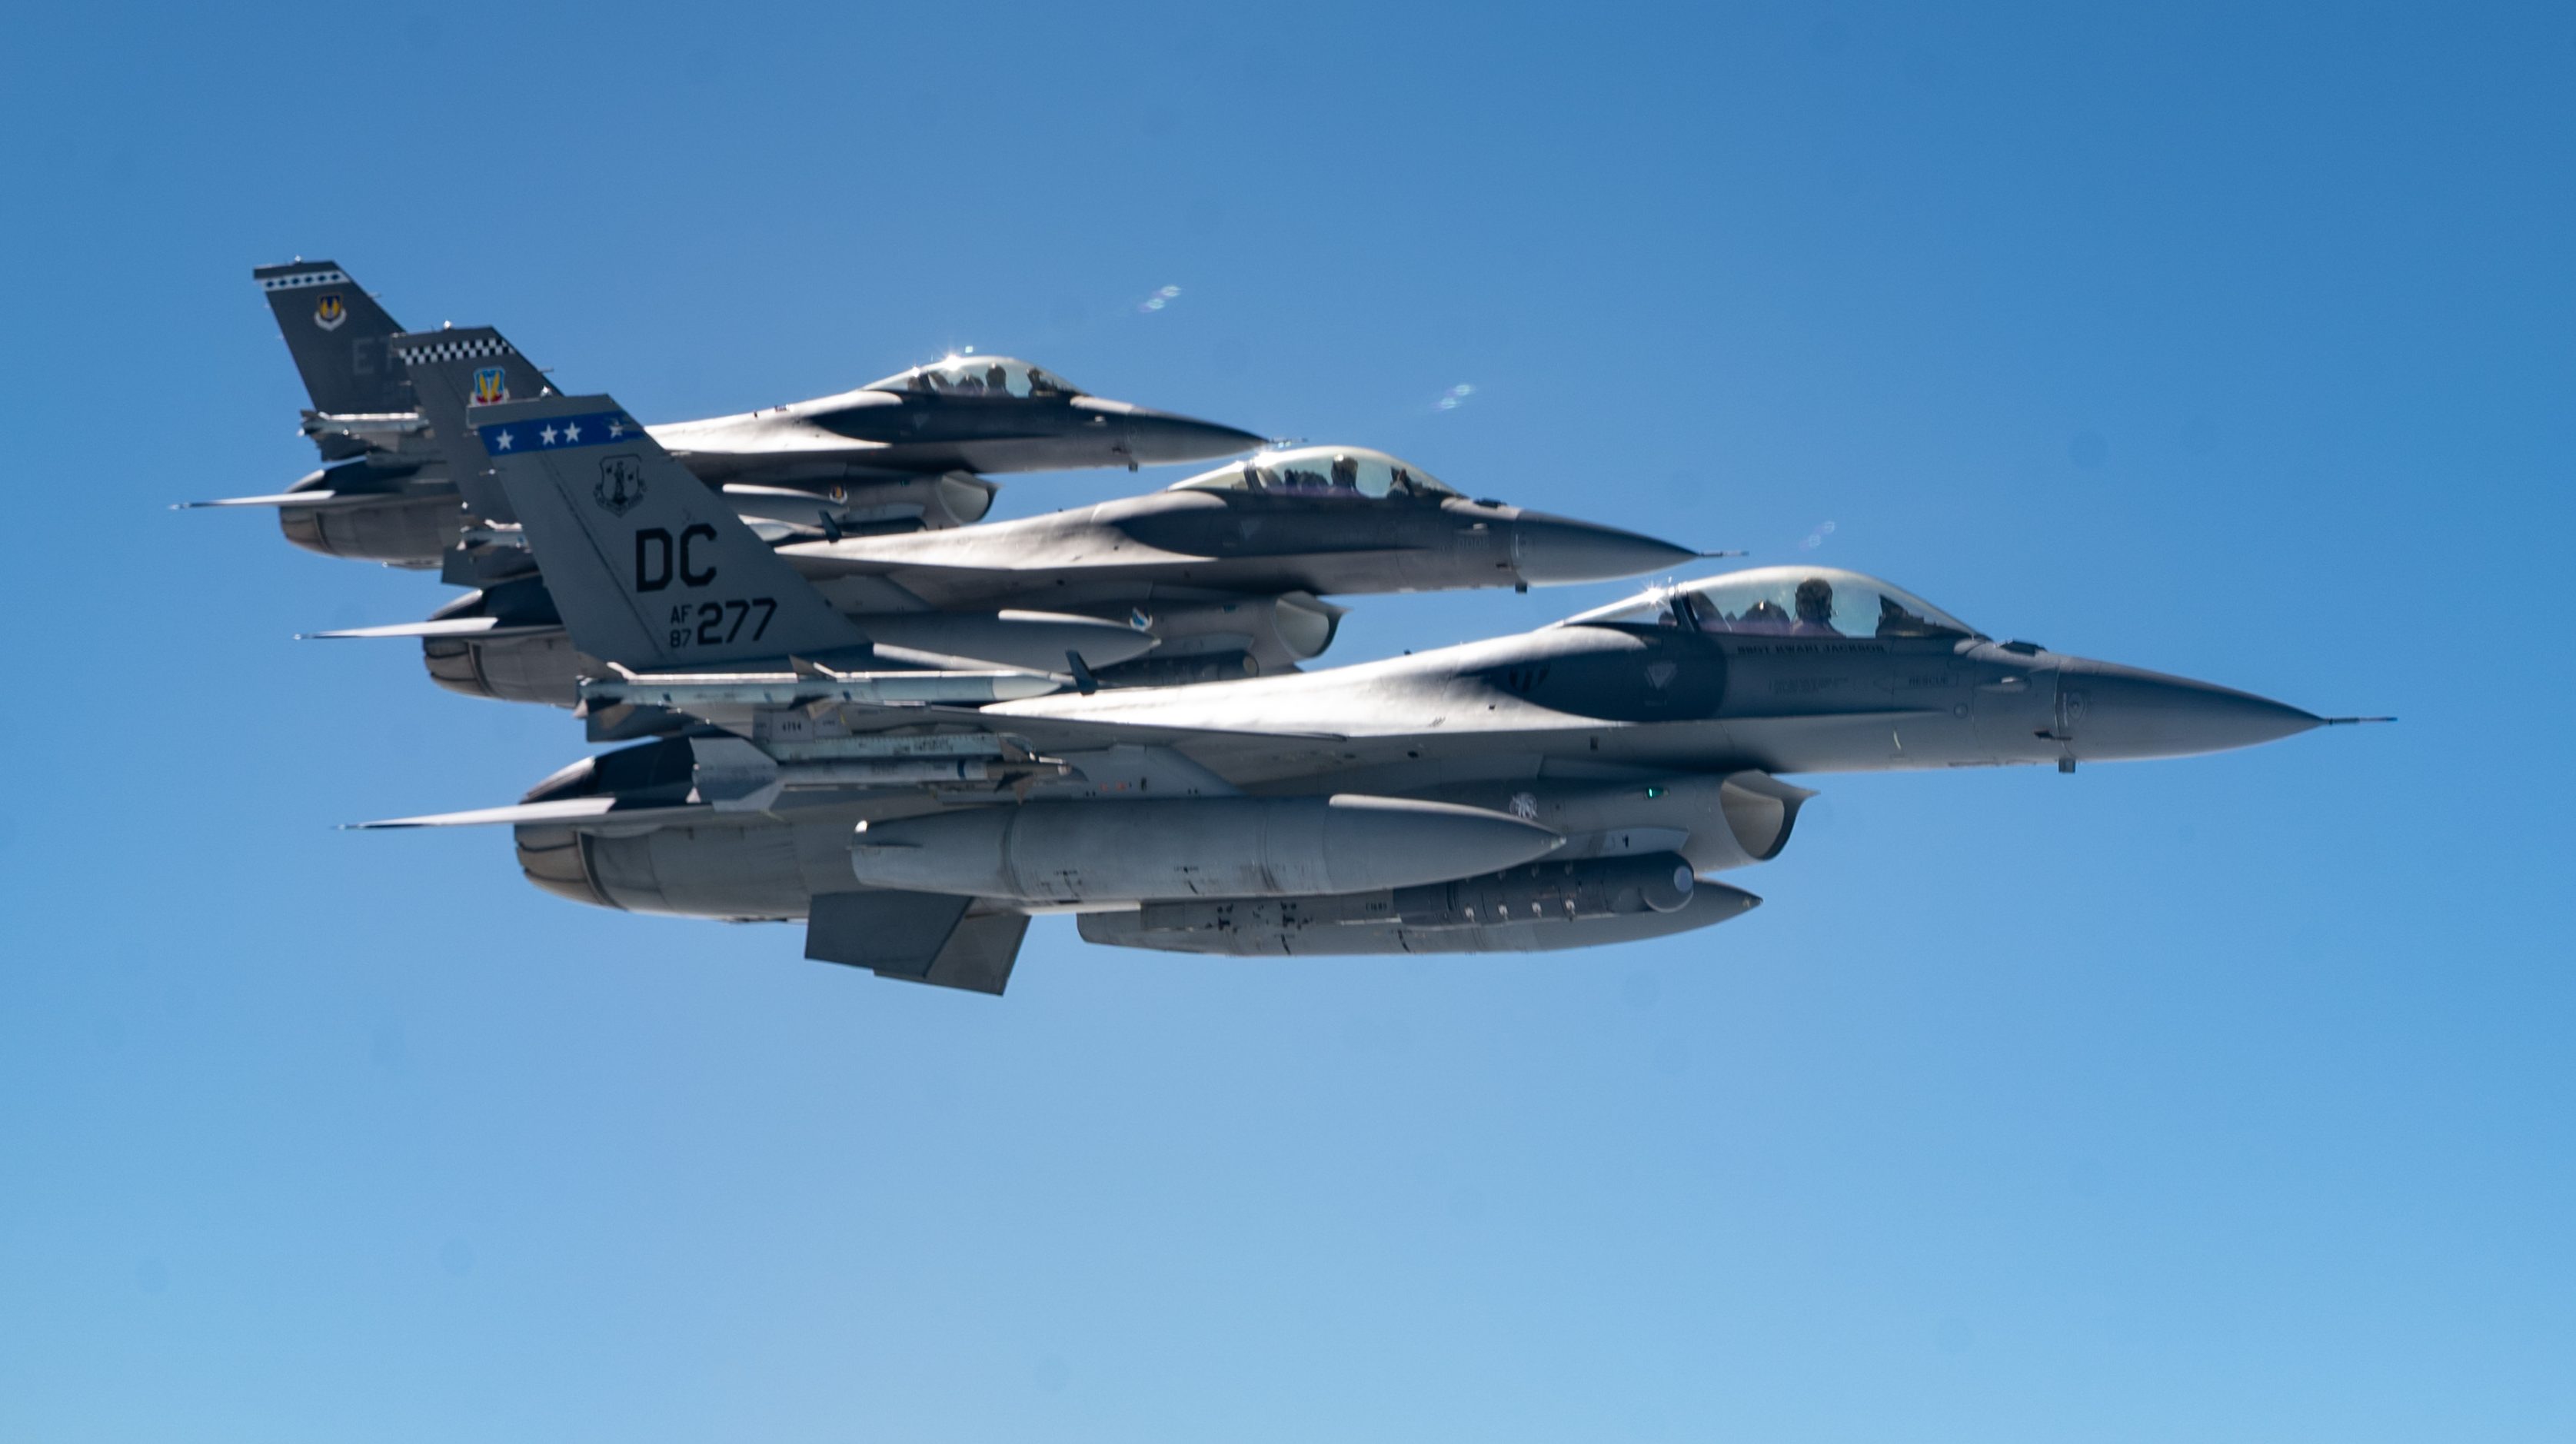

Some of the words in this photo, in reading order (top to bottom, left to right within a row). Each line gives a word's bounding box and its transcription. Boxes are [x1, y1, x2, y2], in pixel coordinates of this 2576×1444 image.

[636, 523, 717, 593] DC
[671, 604, 692, 625] AF
[697, 597, 777, 645] 277
[670, 628, 691, 648] 87
[1909, 677, 1949, 687] RESCUE
